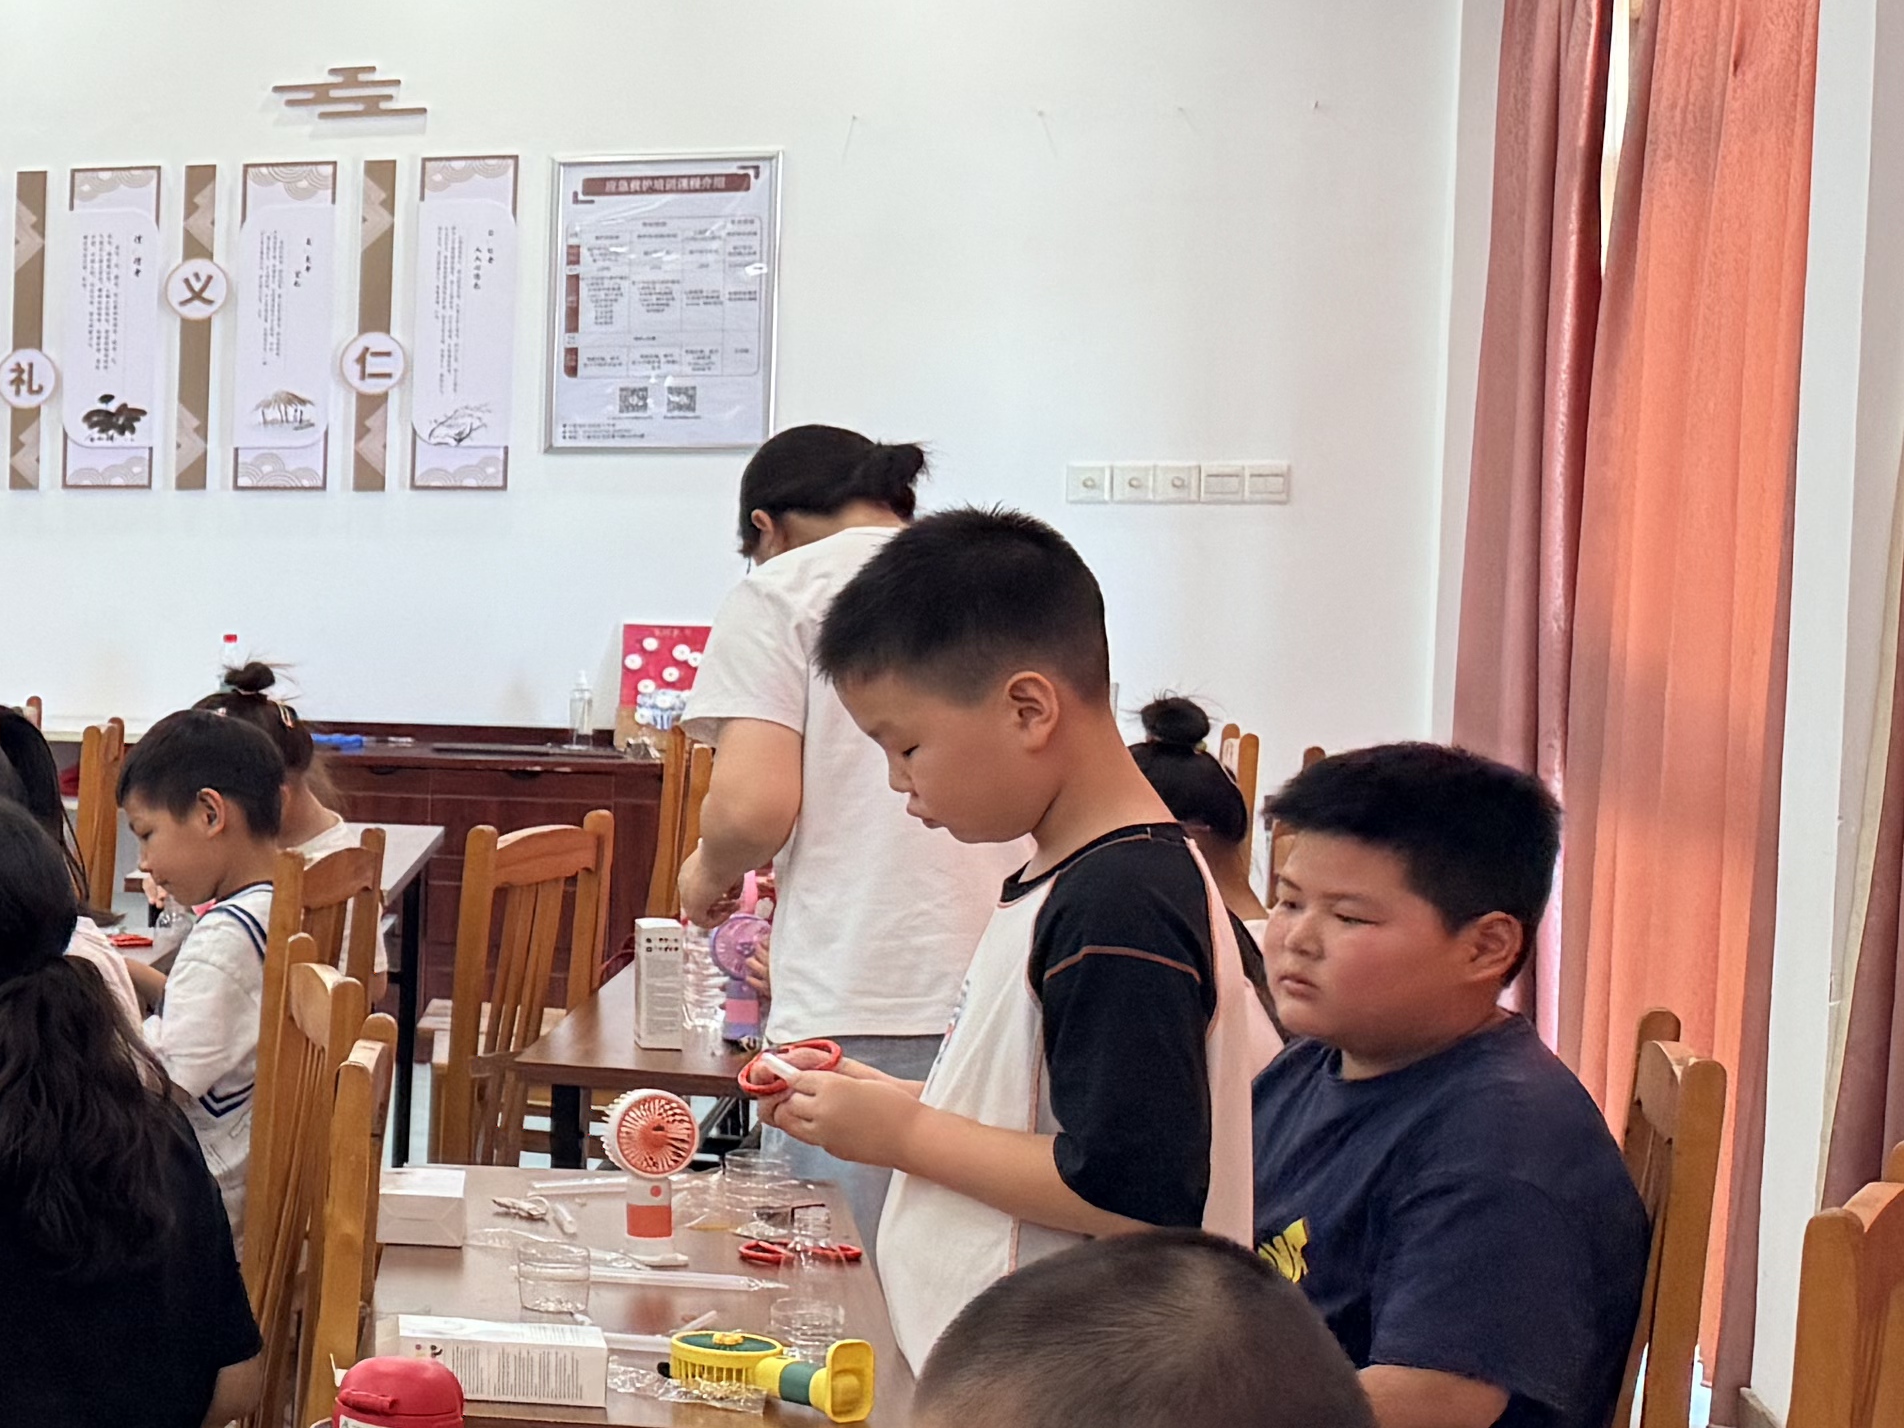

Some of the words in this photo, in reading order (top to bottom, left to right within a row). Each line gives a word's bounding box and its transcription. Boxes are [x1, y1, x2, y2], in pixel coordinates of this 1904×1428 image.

[178, 272, 215, 307] 义
[8, 361, 44, 396] 礼
[355, 346, 394, 381] 仁
